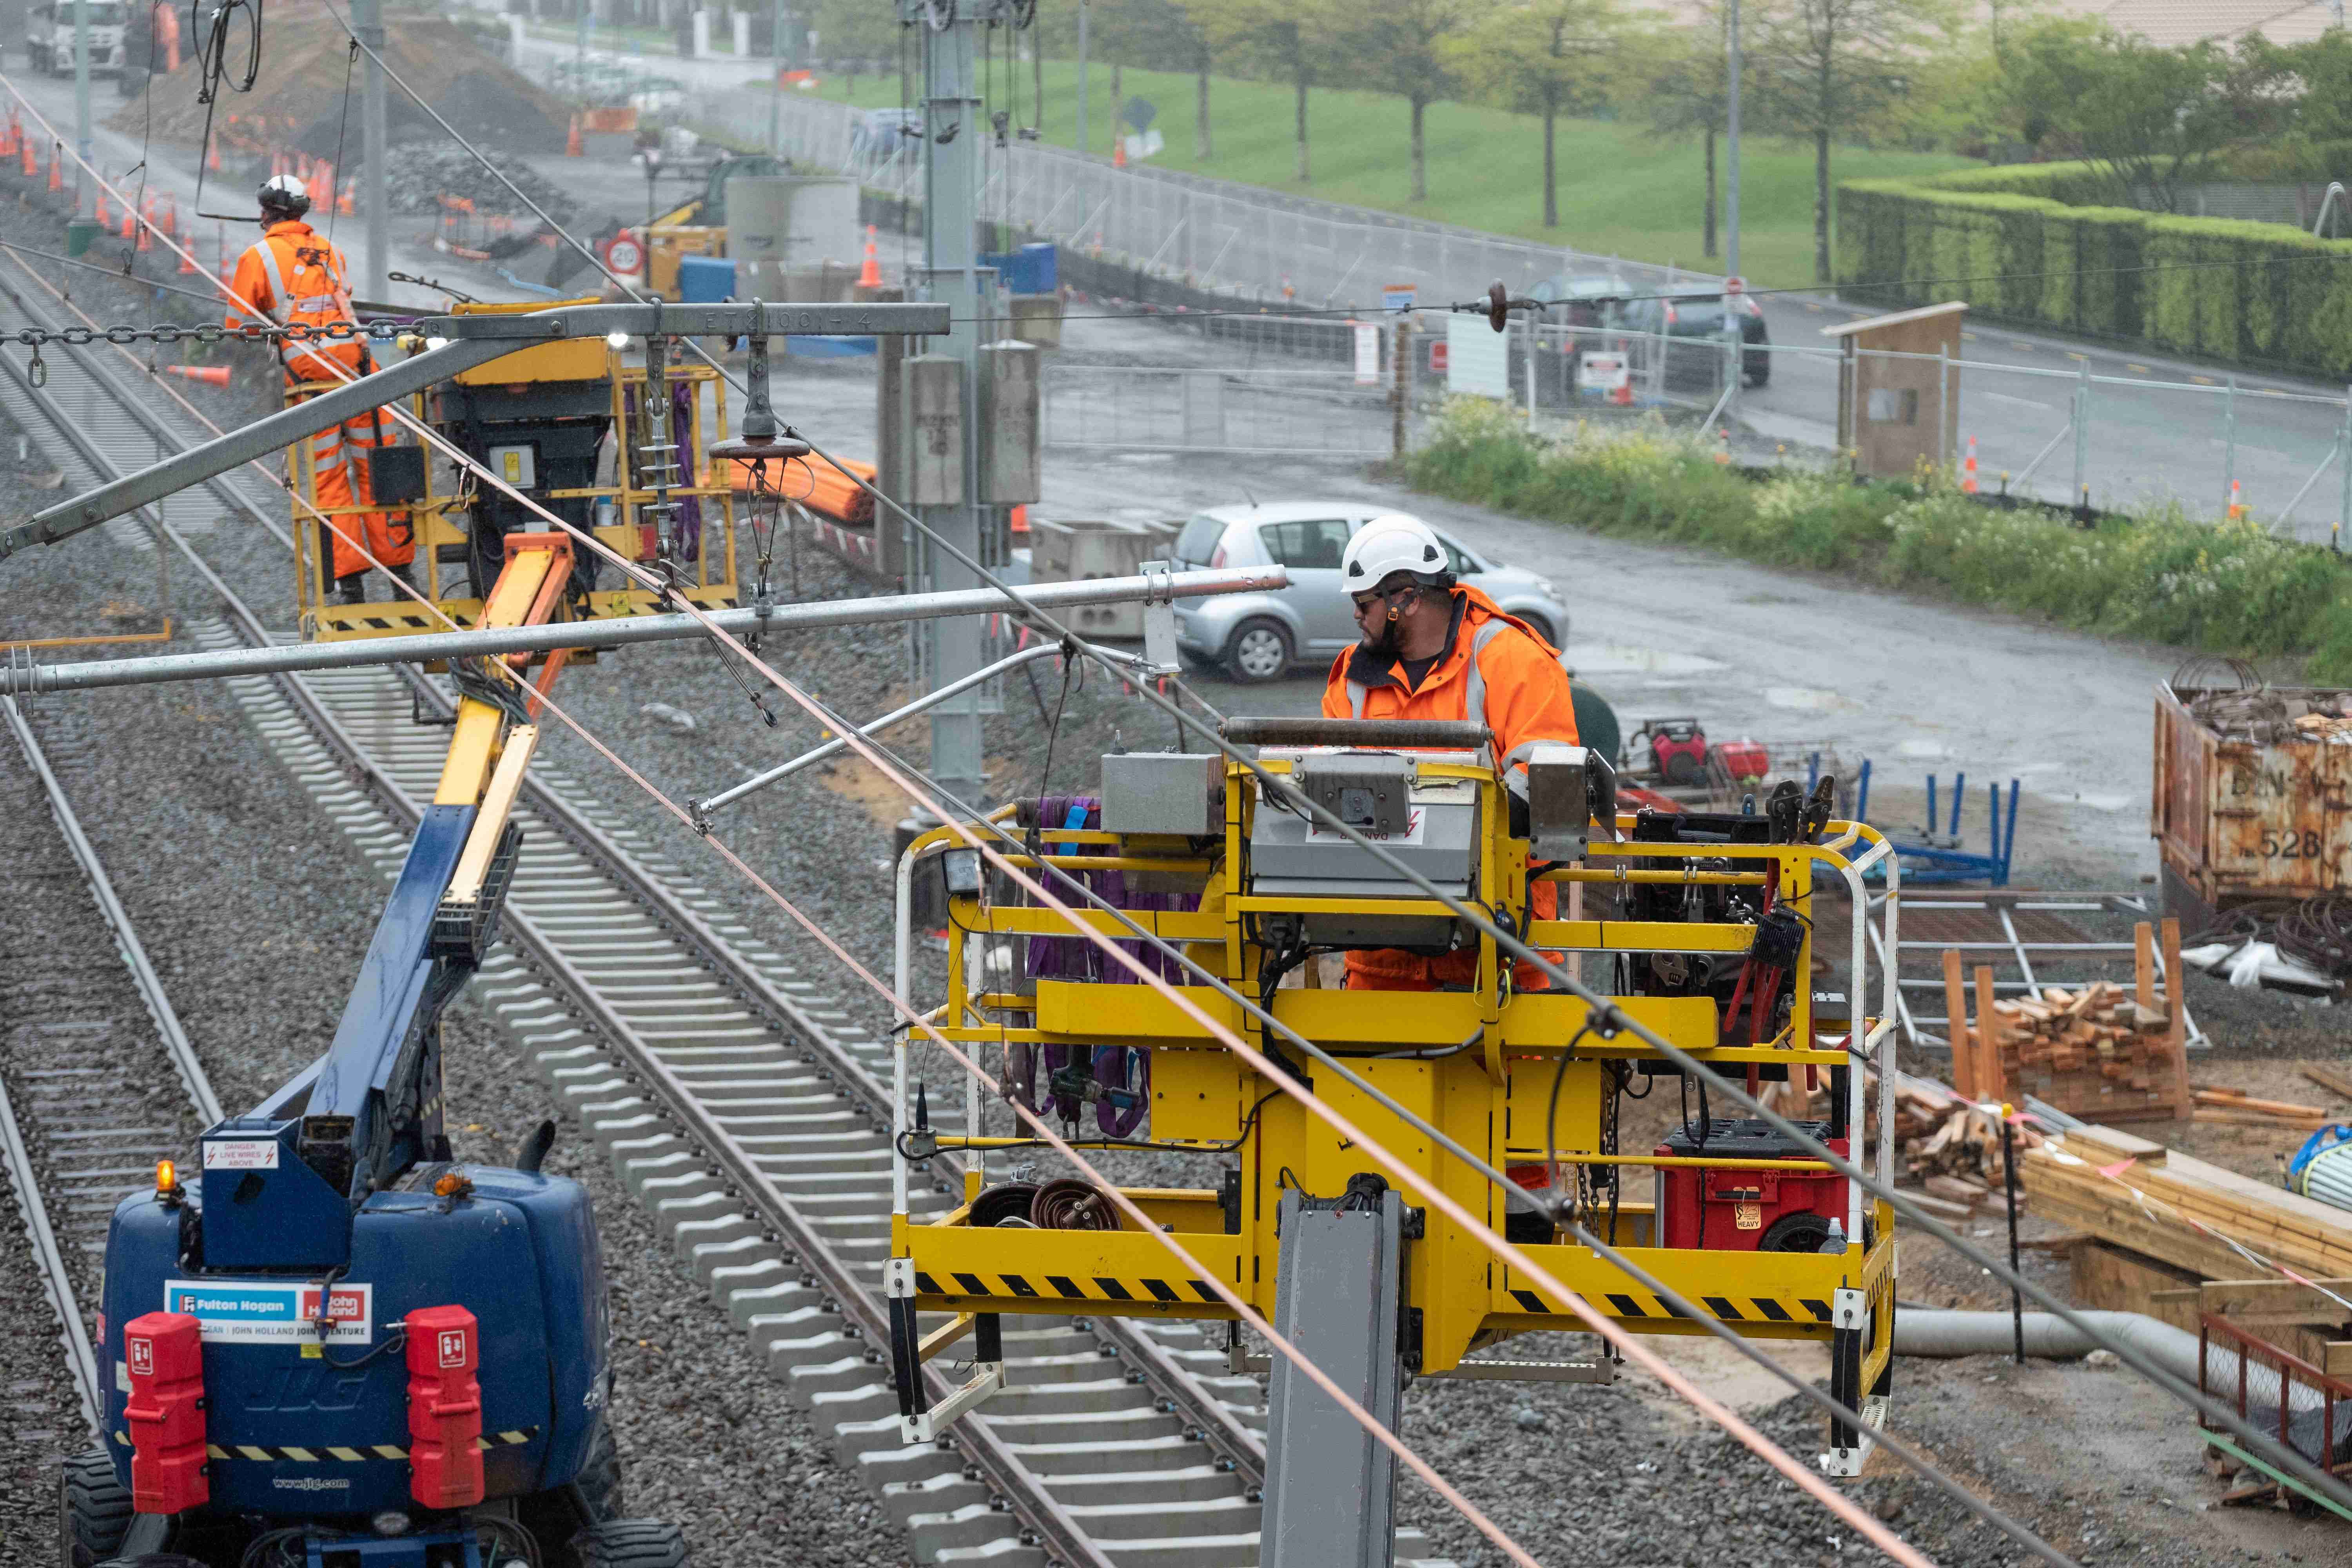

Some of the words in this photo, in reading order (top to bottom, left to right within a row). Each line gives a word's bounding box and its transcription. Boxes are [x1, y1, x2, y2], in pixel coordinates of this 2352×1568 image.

[614, 248, 634, 264] 20
[1339, 832, 1388, 840] DANR
[2262, 828, 2321, 858] 528
[197, 1299, 237, 1310] Fulton
[240, 1301, 284, 1312] Hogan
[232, 1327, 252, 1335] JOHN
[255, 1327, 294, 1336] HOLLAND
[273, 1478, 350, 1491] www.jlg.com
